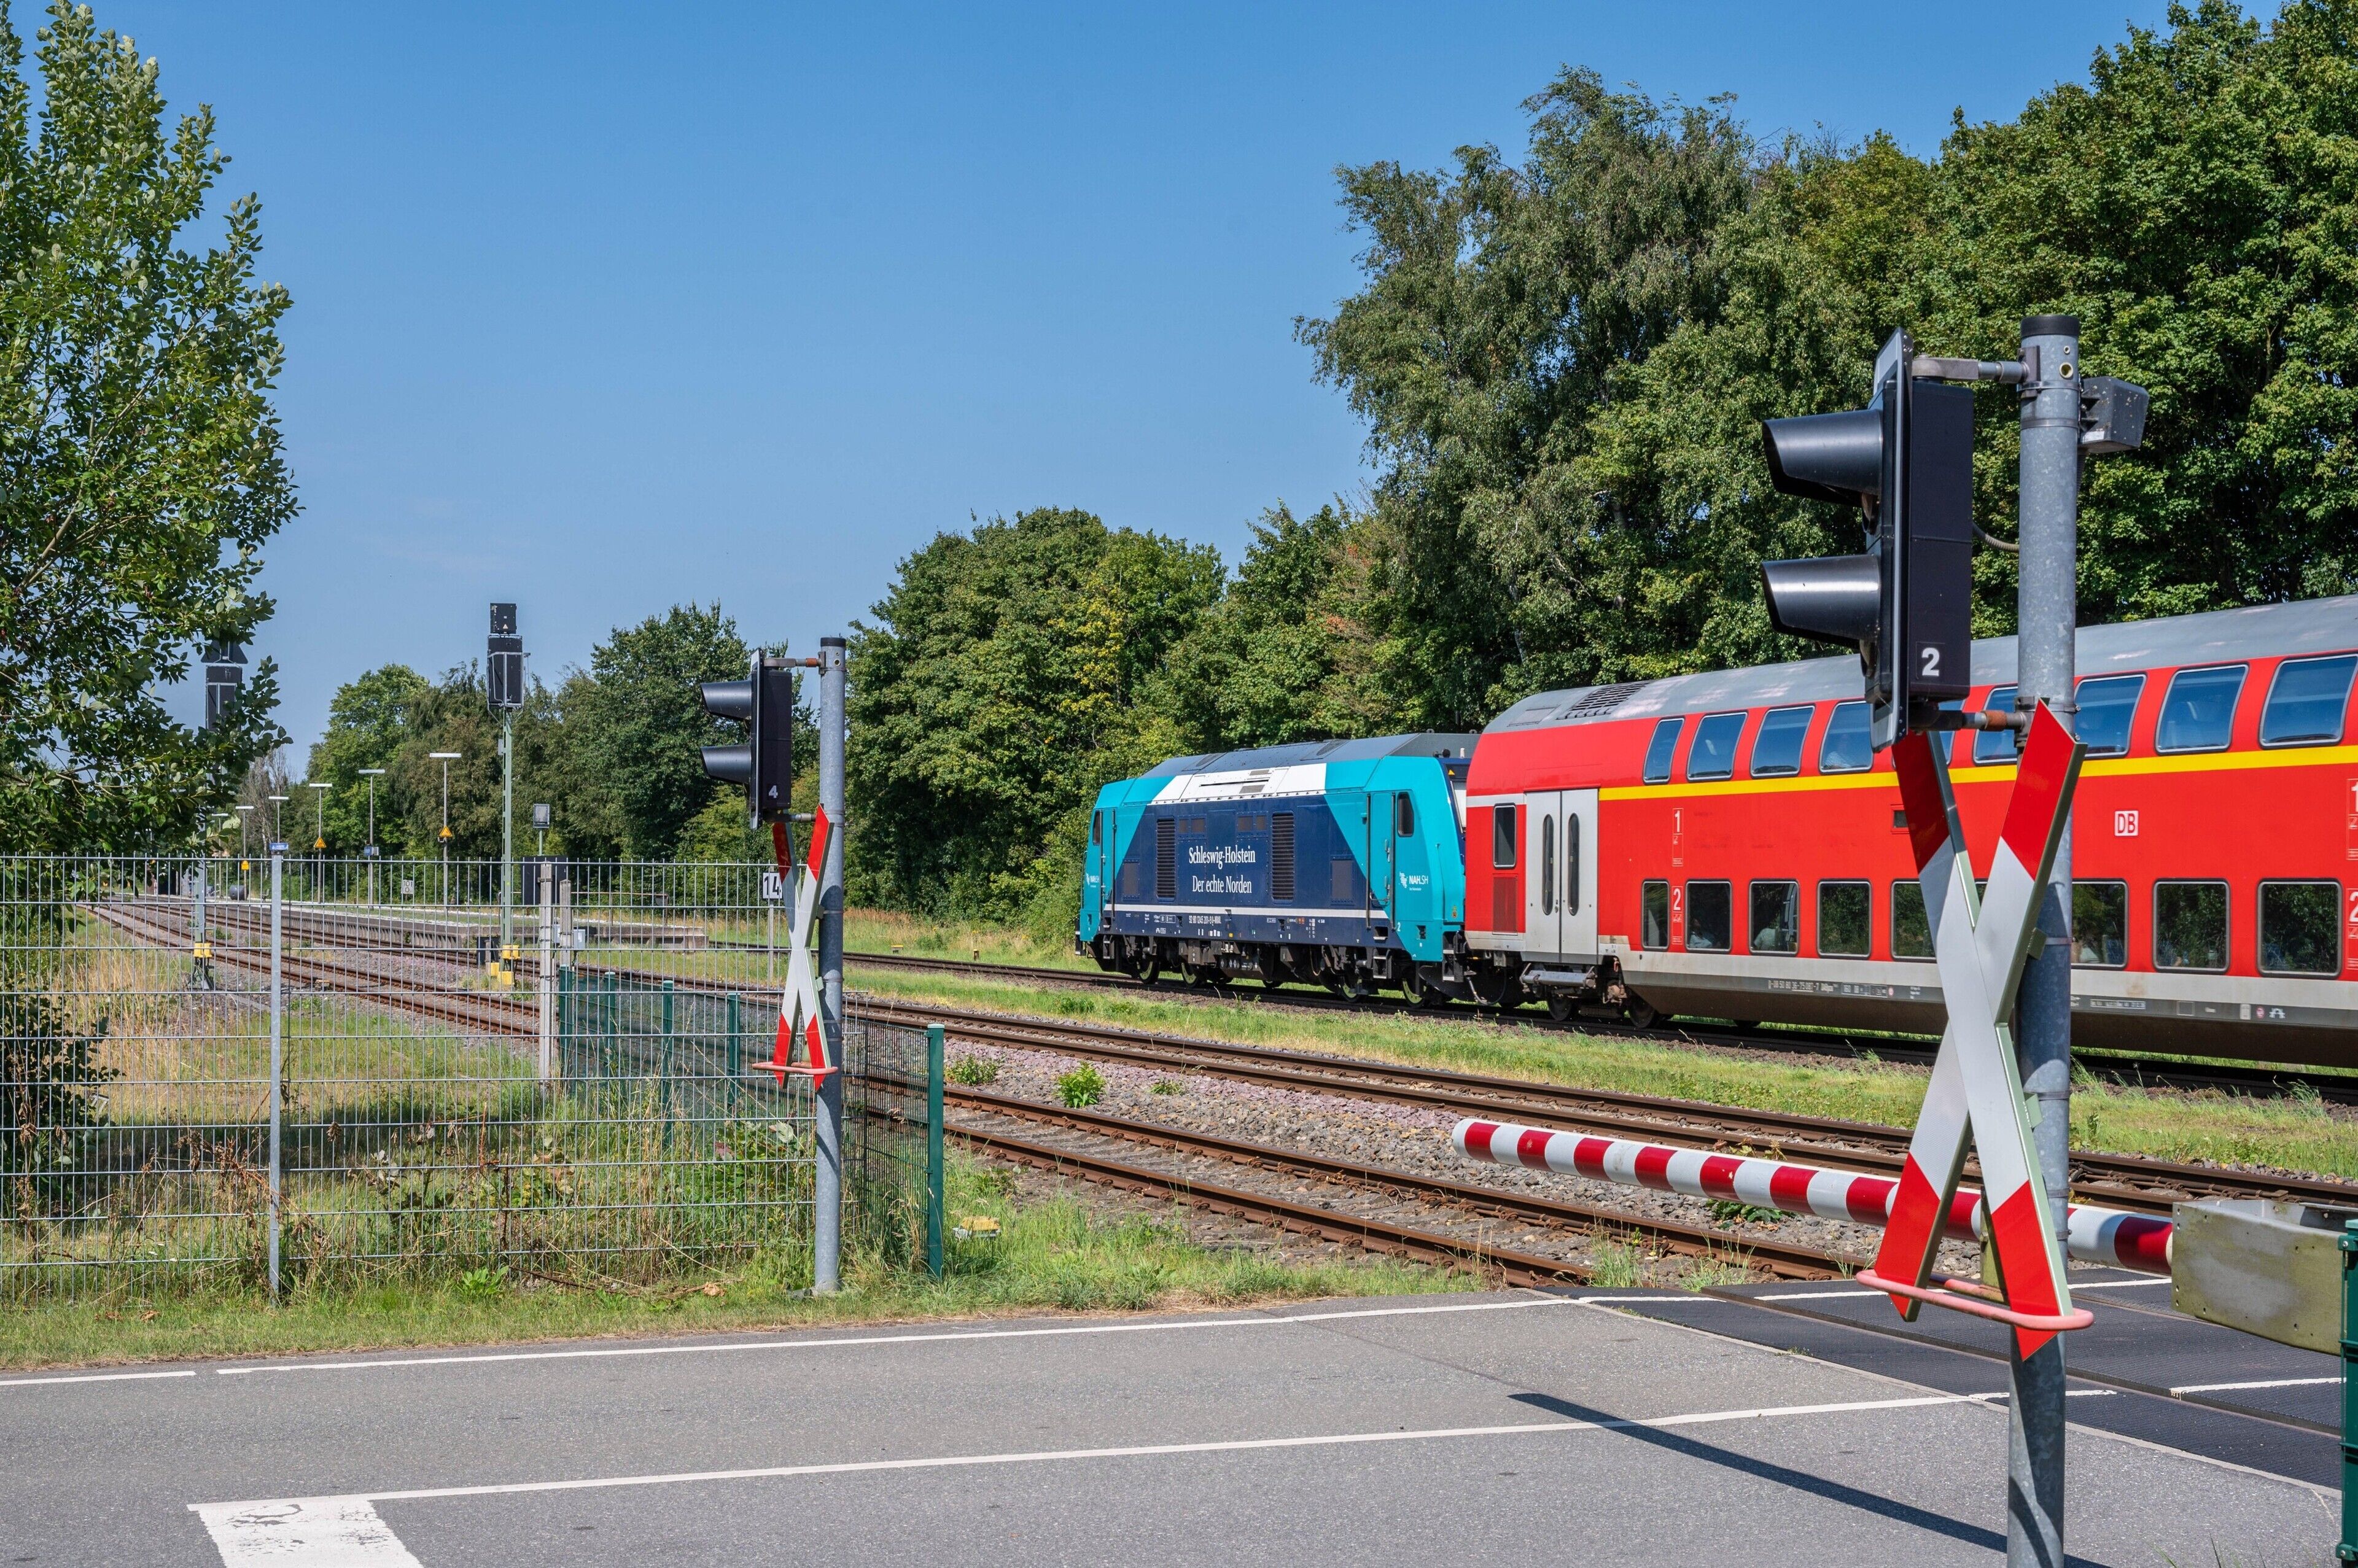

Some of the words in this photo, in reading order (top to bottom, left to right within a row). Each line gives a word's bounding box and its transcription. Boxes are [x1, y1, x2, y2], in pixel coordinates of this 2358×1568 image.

[1921, 647, 1940, 677] 2
[768, 785, 779, 799] 4
[1674, 810, 1681, 833] 1
[2117, 813, 2136, 834] DB
[1189, 845, 1256, 869] Schleswig-Holstein
[1193, 875, 1204, 892] Der
[1205, 874, 1224, 893] echte
[1226, 874, 1252, 893] Norden
[1409, 875, 1428, 885] NAH.SH
[1673, 888, 1681, 910] 2
[1397, 922, 1401, 931] 2
